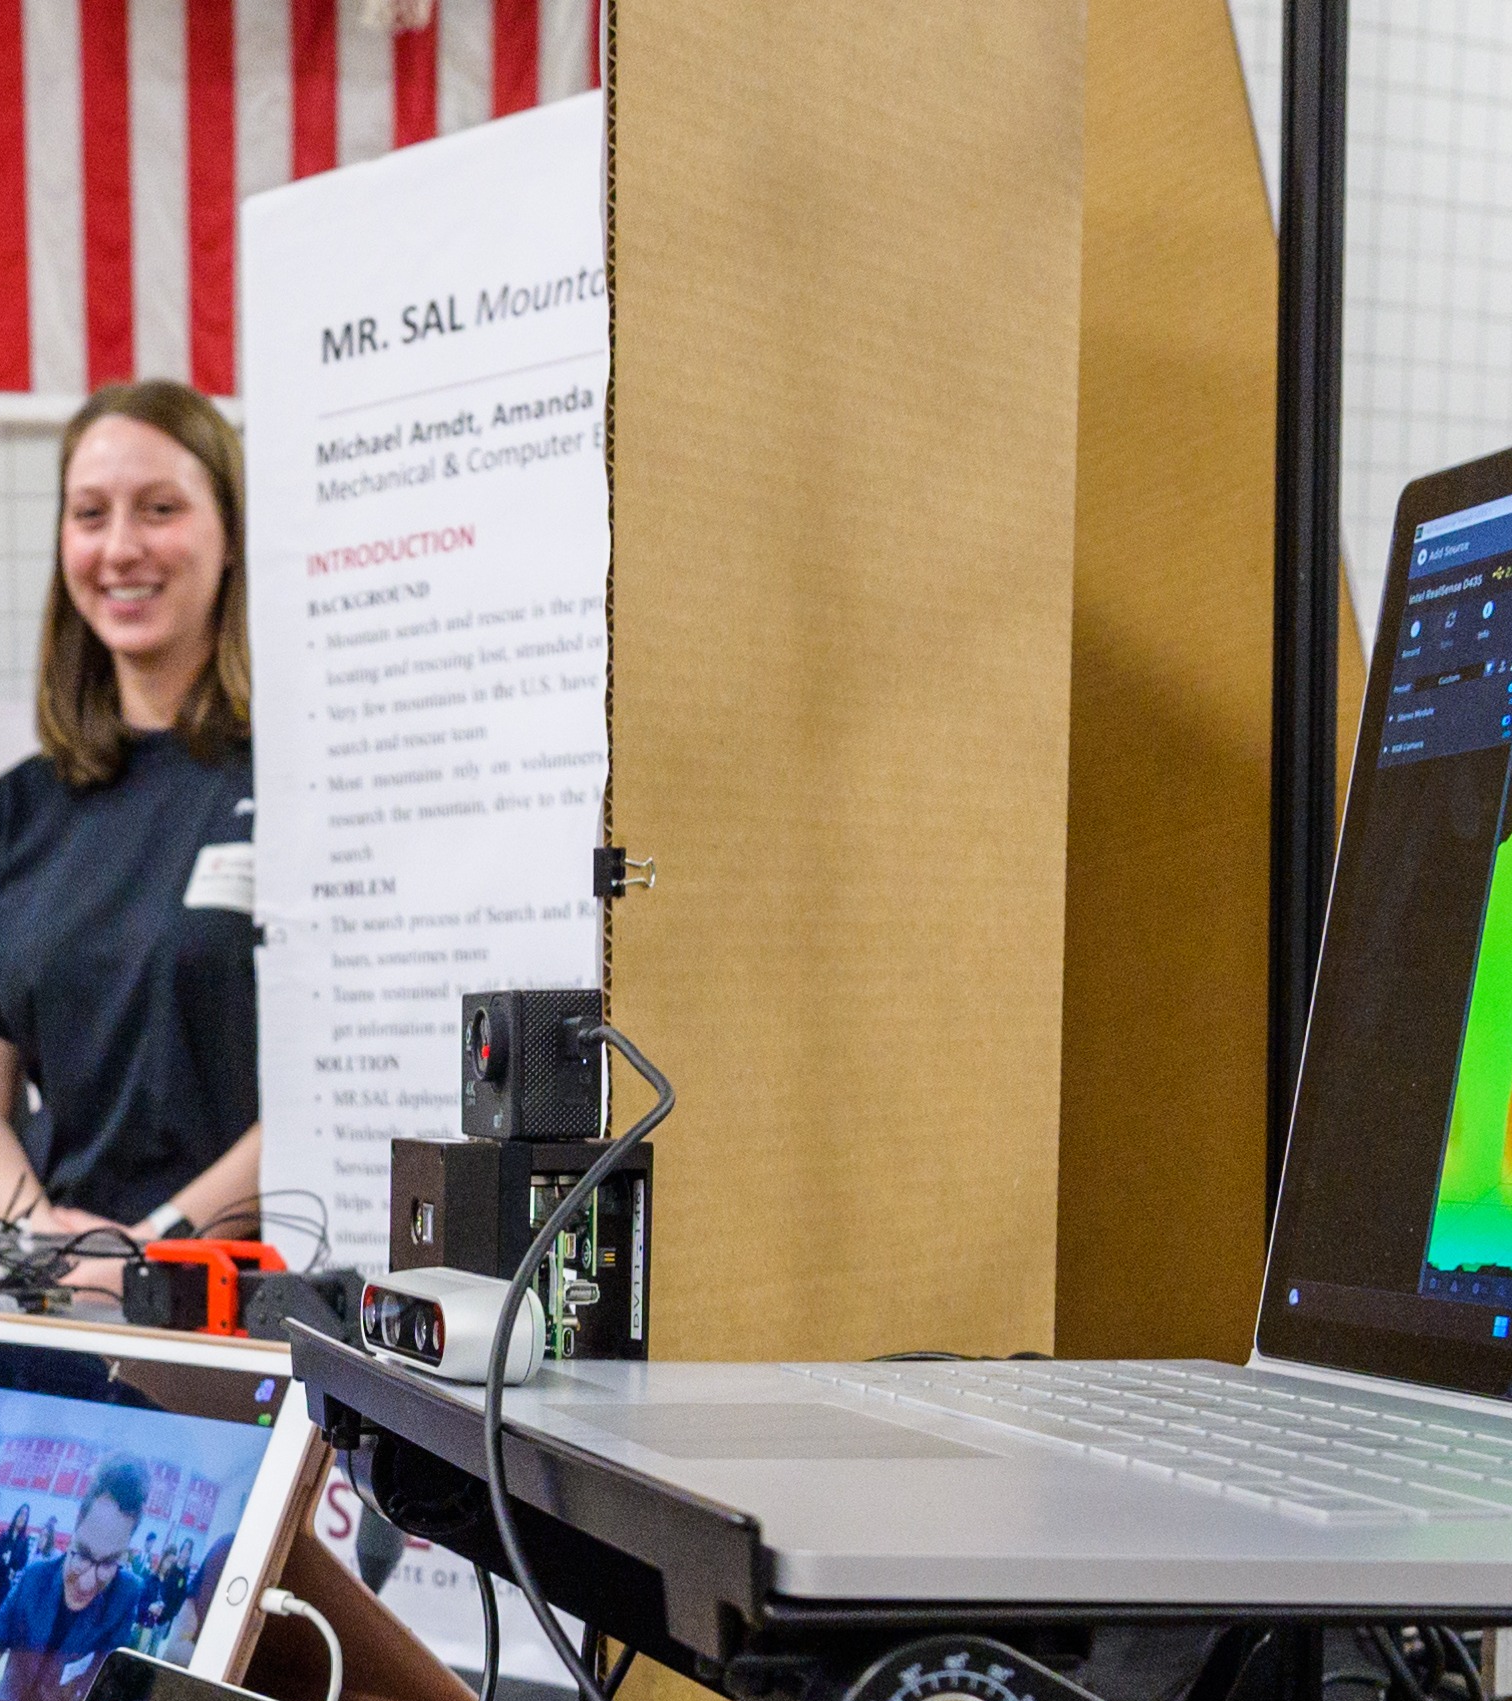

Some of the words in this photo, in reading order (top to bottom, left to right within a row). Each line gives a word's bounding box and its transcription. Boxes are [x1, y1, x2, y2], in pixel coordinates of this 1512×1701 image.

[322, 316, 389, 365] MR.
[401, 295, 466, 346] SAL
[316, 424, 403, 468] Michael
[409, 410, 483, 446] Arndt,
[491, 385, 595, 428] Amanda
[317, 457, 436, 504] Mechanical
[443, 452, 460, 478] &
[467, 430, 585, 474] Computer
[307, 523, 476, 577] INTRODUCTION
[308, 580, 431, 618] BACKGROUND
[326, 627, 391, 650] Mountain
[395, 616, 442, 640] search
[447, 611, 474, 632] and
[478, 605, 527, 627] rescue
[532, 602, 545, 618] is
[550, 596, 575, 615] the
[384, 657, 409, 678] and
[413, 651, 475, 674] rescuing
[479, 647, 509, 666] lost,
[516, 633, 583, 660] stranded
[363, 698, 386, 718] few
[392, 690, 467, 713] mountains
[472, 686, 488, 703] in
[492, 681, 514, 701] the
[560, 671, 599, 691] have
[329, 739, 370, 759] search
[375, 733, 400, 753] and
[405, 728, 447, 748] rescue
[371, 768, 443, 789] mountains
[491, 759, 511, 775] on
[390, 806, 413, 824] the
[538, 790, 555, 806] to
[560, 786, 587, 806] the
[312, 877, 397, 898] PROBLEM
[331, 915, 358, 934] The
[464, 906, 482, 925] of
[486, 903, 537, 924] Search
[543, 901, 571, 920] and
[314, 1054, 400, 1073] SOLUTION
[432, 1569, 459, 1588] OF
